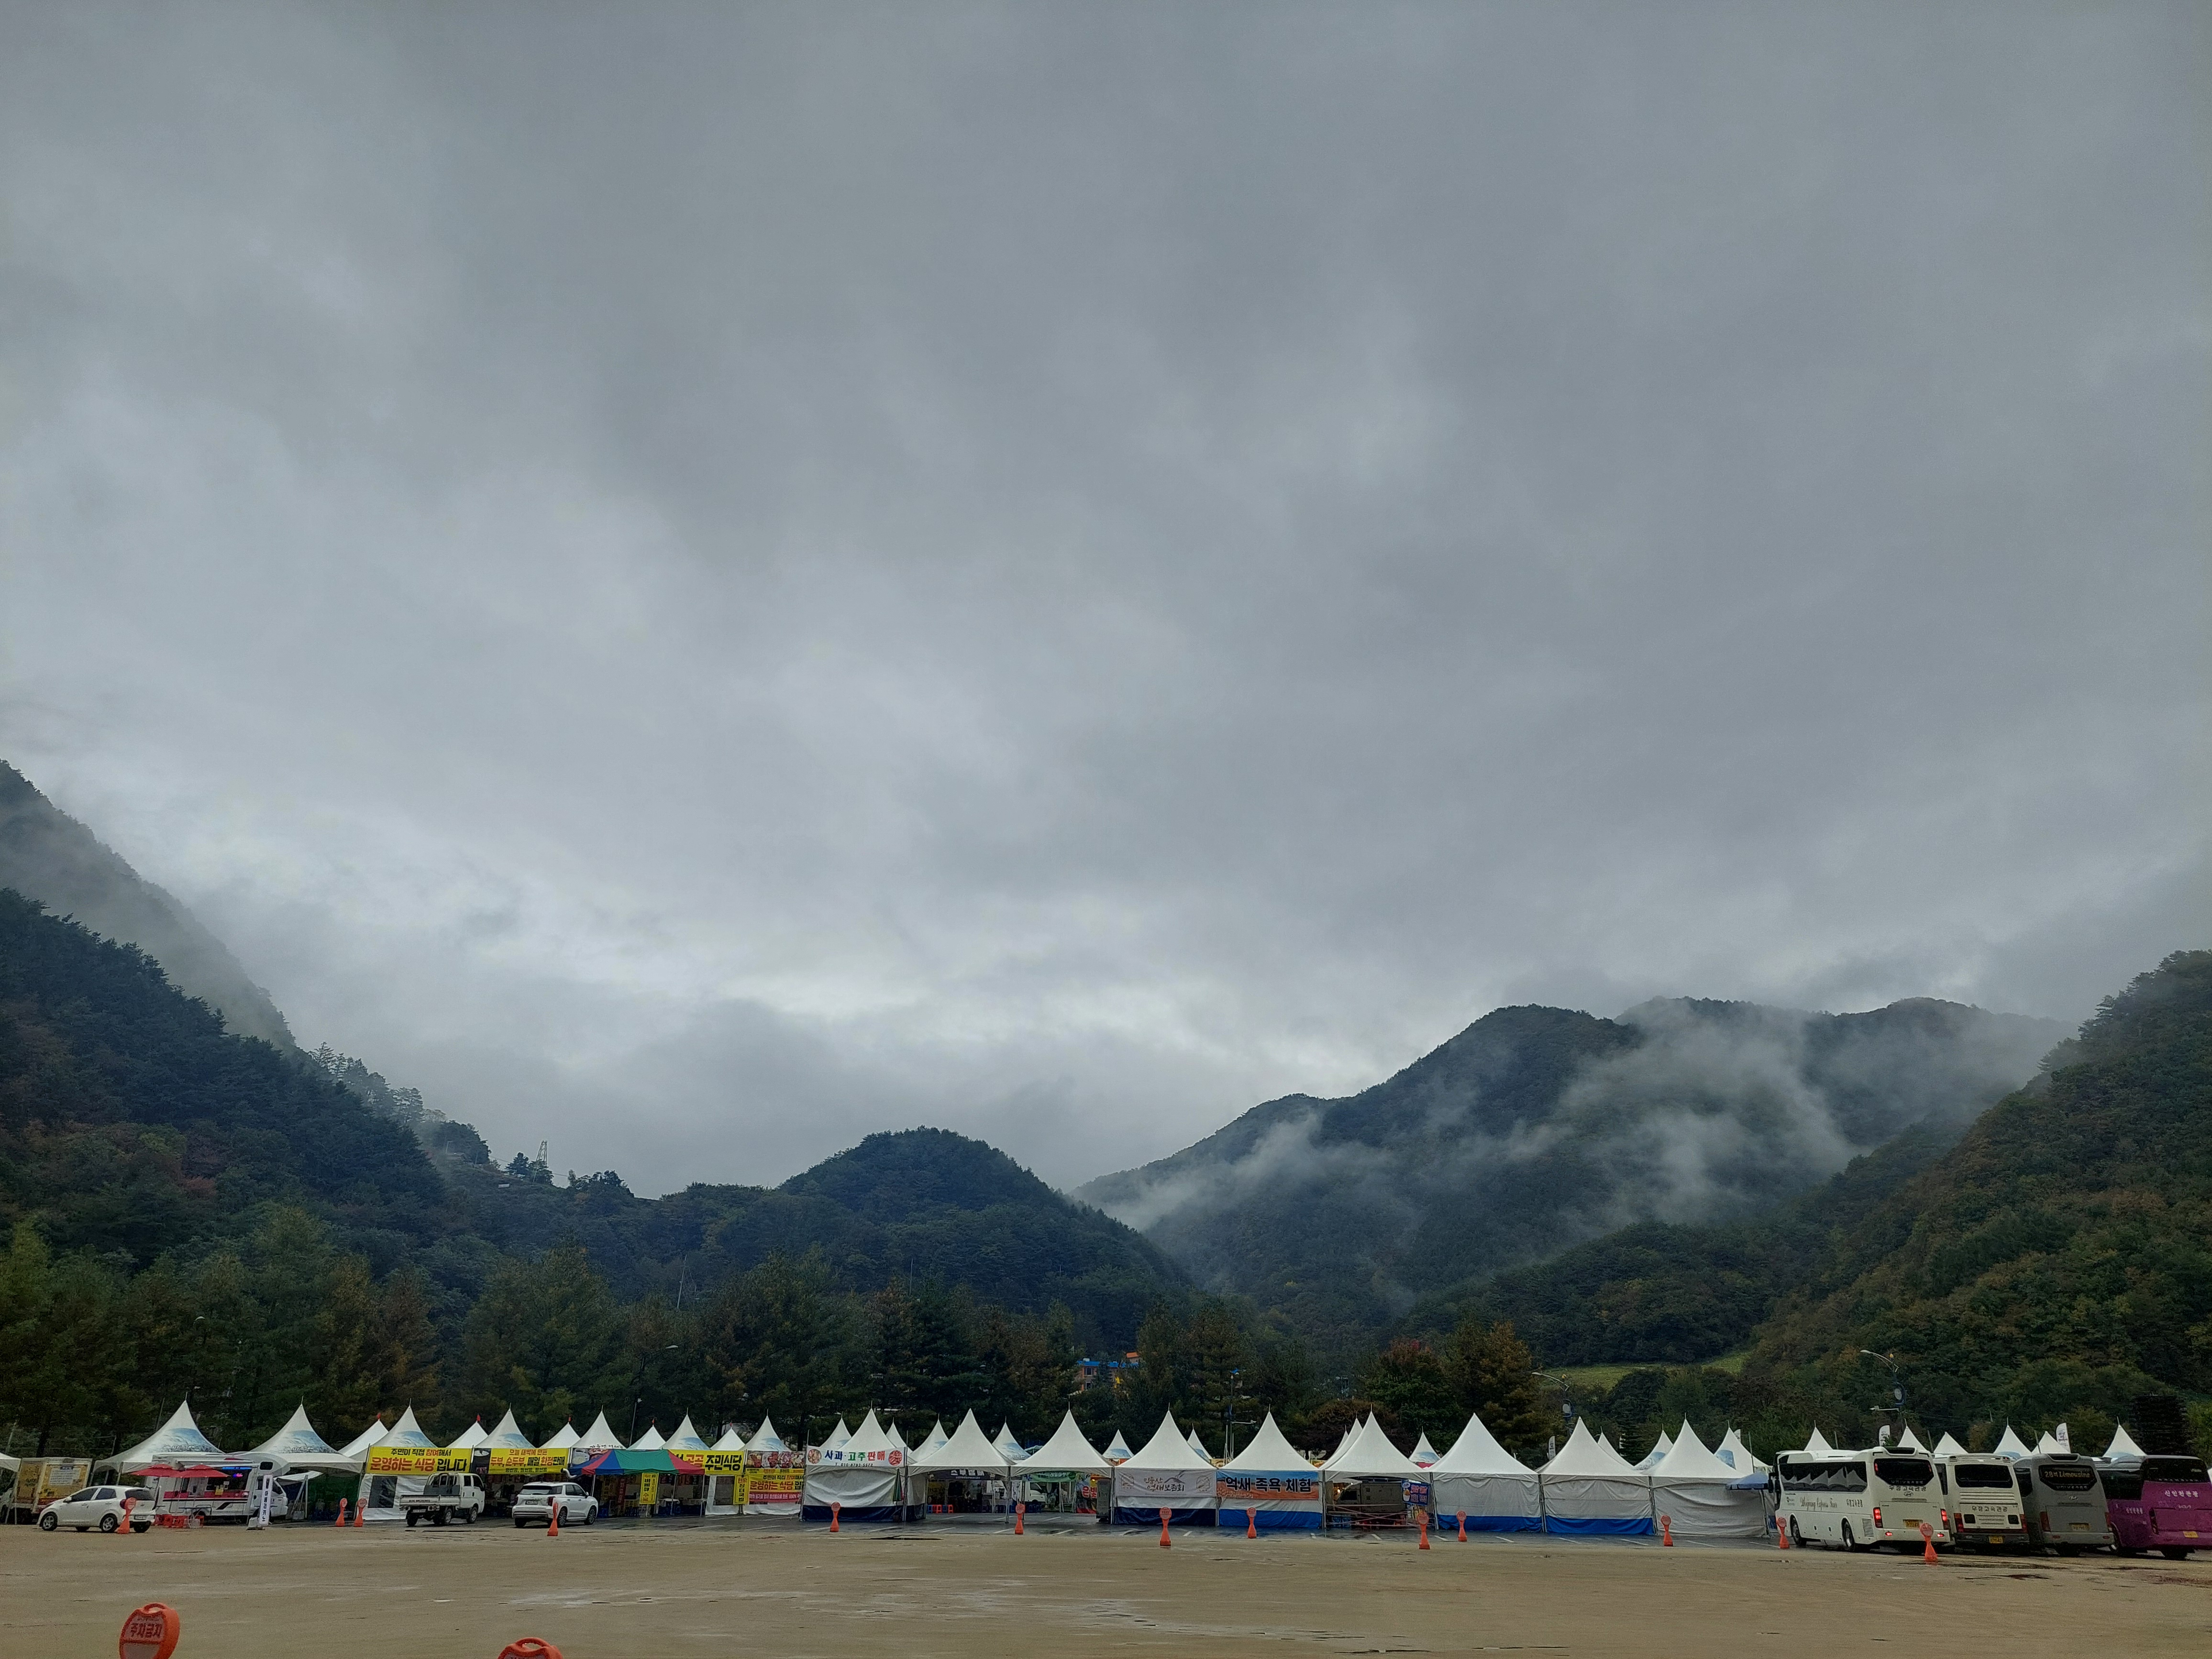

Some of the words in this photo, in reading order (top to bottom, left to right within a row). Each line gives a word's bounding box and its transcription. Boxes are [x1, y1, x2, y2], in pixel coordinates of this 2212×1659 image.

[370, 1457, 412, 1471] 운영하는
[415, 1458, 436, 1472] 식당
[436, 1458, 467, 1472] 입니다
[527, 1456, 540, 1466] 매일
[541, 1456, 565, 1466] 한정판매
[705, 1454, 742, 1471] 주민식당
[750, 1481, 778, 1490] 운영하는
[780, 1481, 794, 1490] 식당
[1225, 1476, 1251, 1491] 억새
[1255, 1477, 1282, 1492] 족욕
[1285, 1478, 1312, 1493] 체험
[131, 1622, 163, 1638] 주차금지
